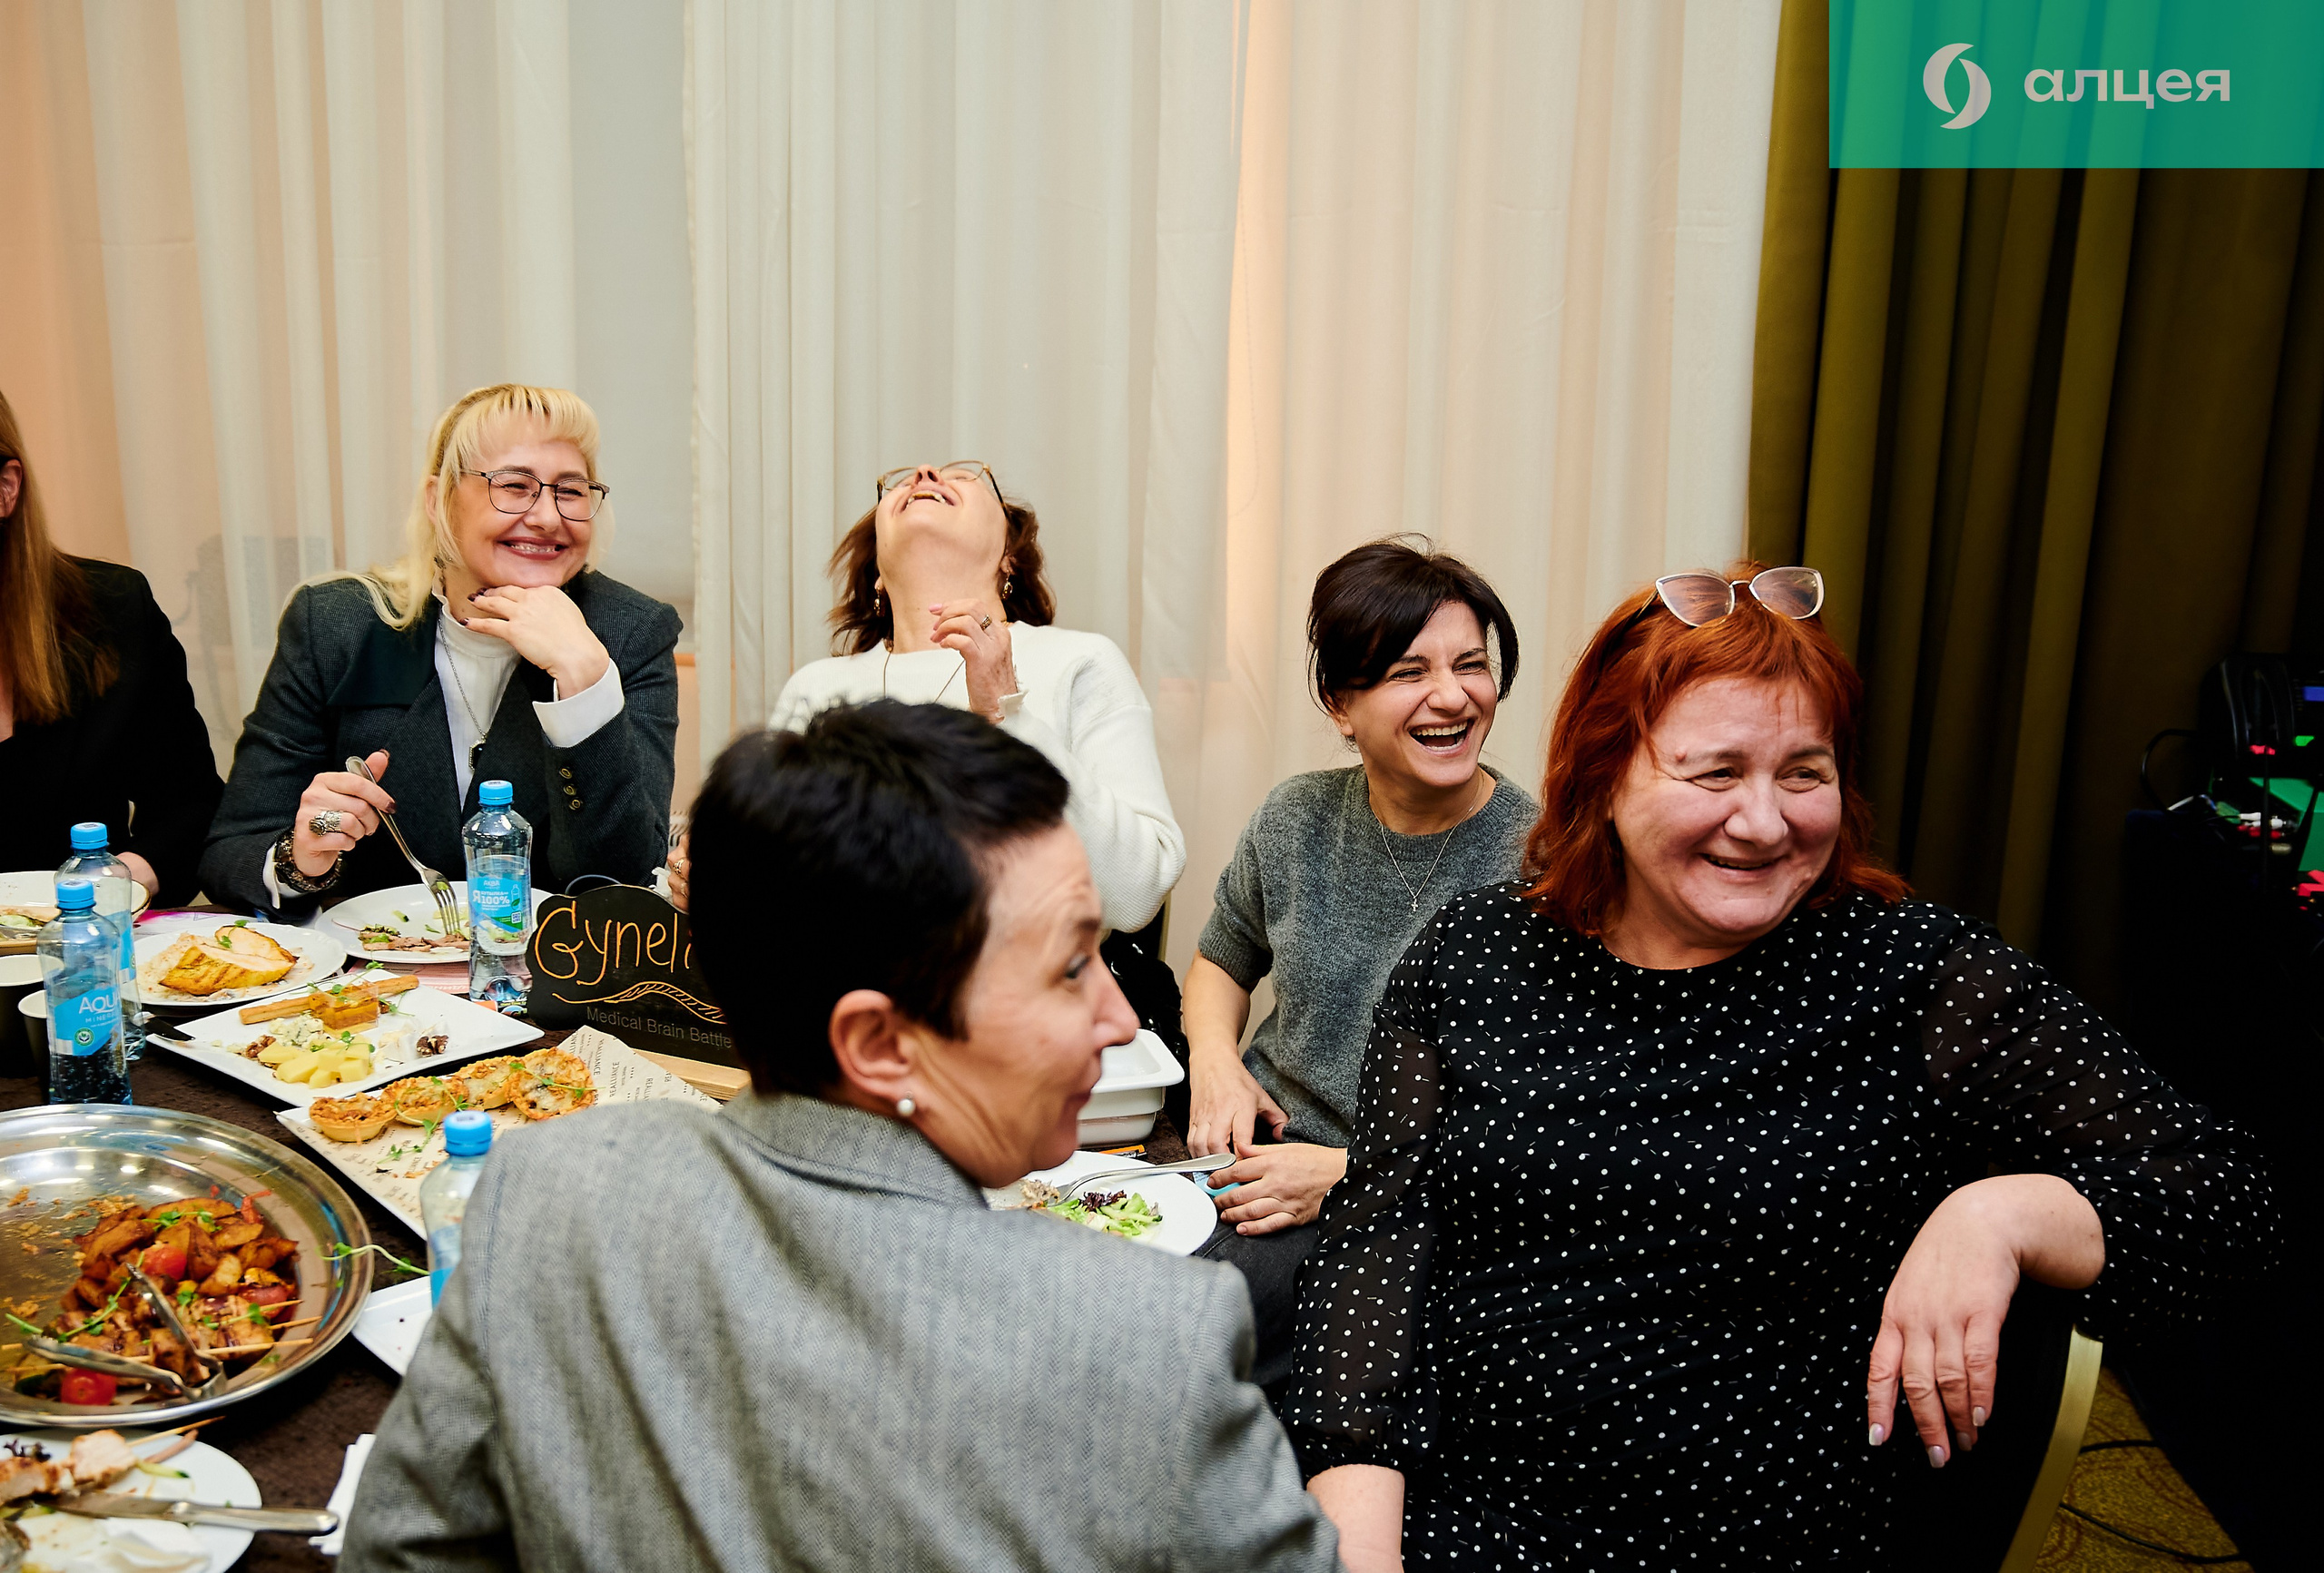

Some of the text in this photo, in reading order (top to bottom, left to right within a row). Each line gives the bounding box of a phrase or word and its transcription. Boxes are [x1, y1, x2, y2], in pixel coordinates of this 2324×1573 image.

[481, 896, 510, 904] 100%
[586, 1007, 732, 1048] Medical Brain Battle
